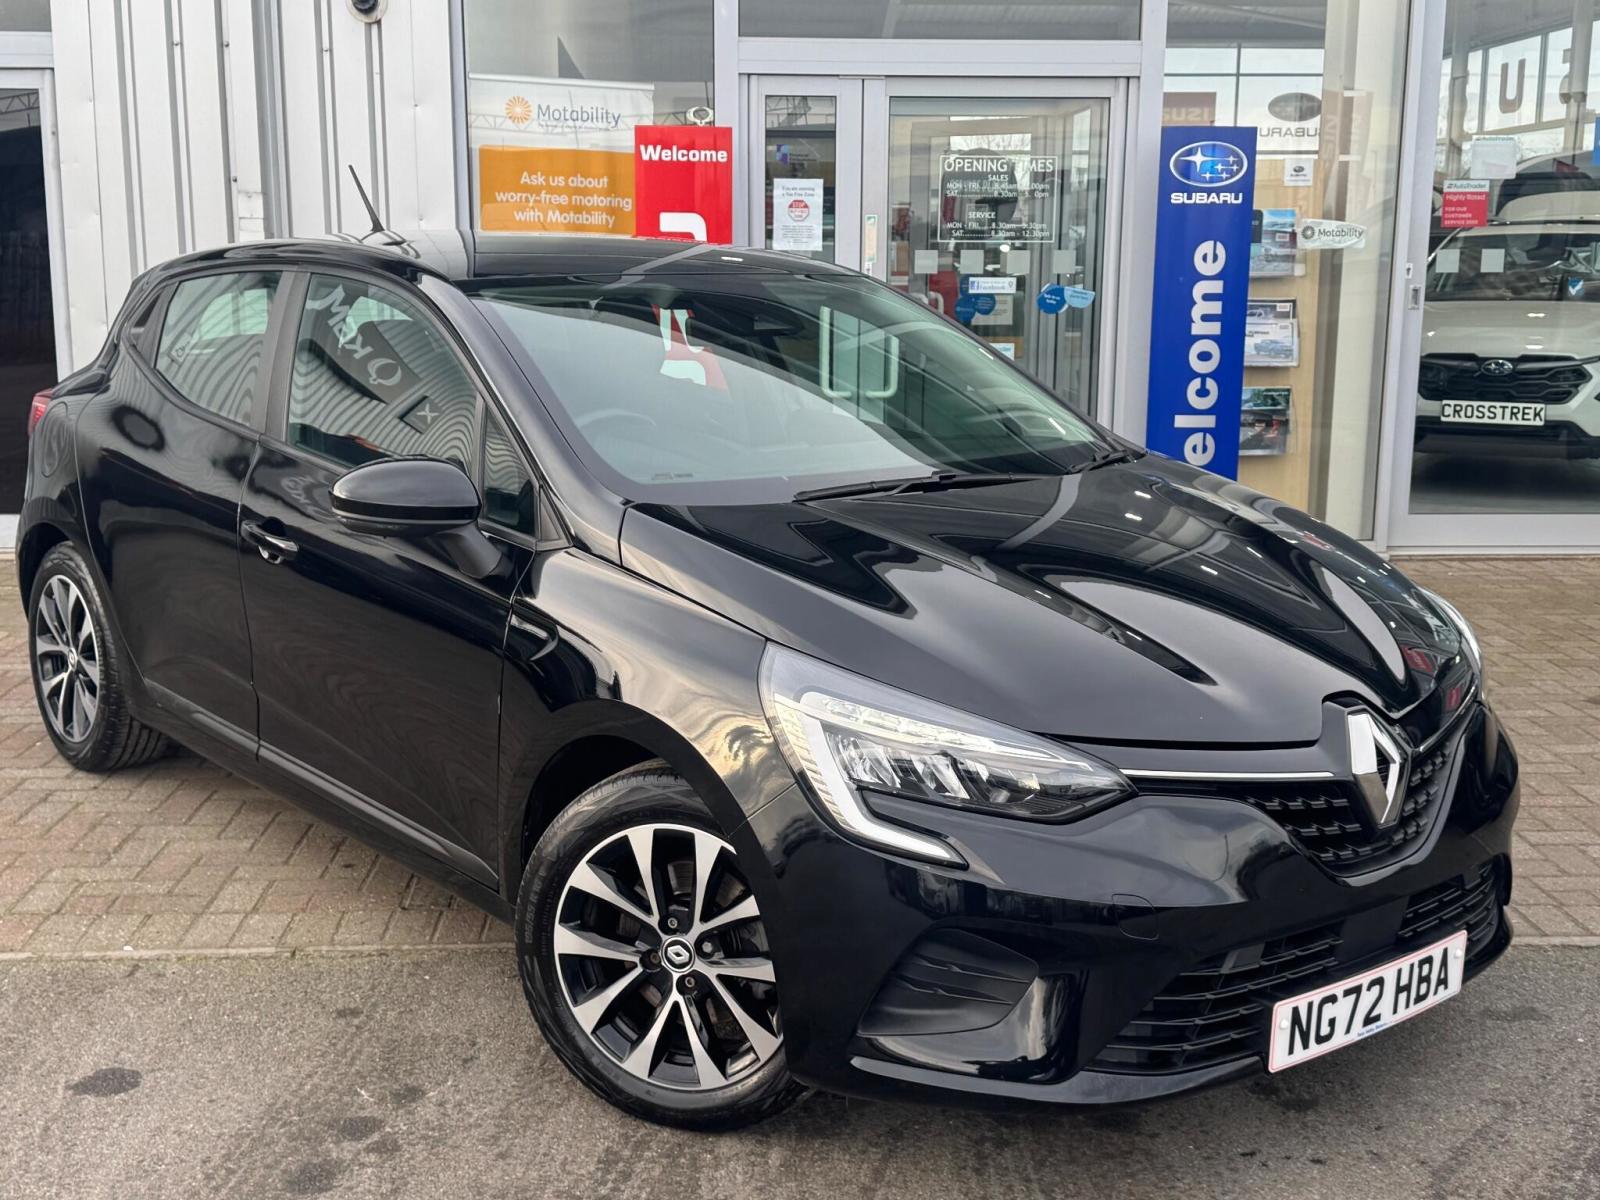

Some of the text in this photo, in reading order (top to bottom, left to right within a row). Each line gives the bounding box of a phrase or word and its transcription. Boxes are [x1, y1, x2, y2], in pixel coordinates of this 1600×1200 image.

[537, 104, 621, 128] Motability
[639, 145, 728, 162] Welcome
[944, 158, 1008, 172] OPENING
[520, 171, 609, 188] Ask us about
[495, 190, 632, 211] worry-free motoring
[1170, 192, 1243, 204] SUBARU
[514, 208, 615, 228] with Motability
[967, 211, 996, 219] SERVICE
[1317, 228, 1364, 240] Motability
[1174, 240, 1226, 467] elcome
[1441, 403, 1544, 422] CROSSTREK
[1288, 947, 1449, 1056] NG72 HBA
